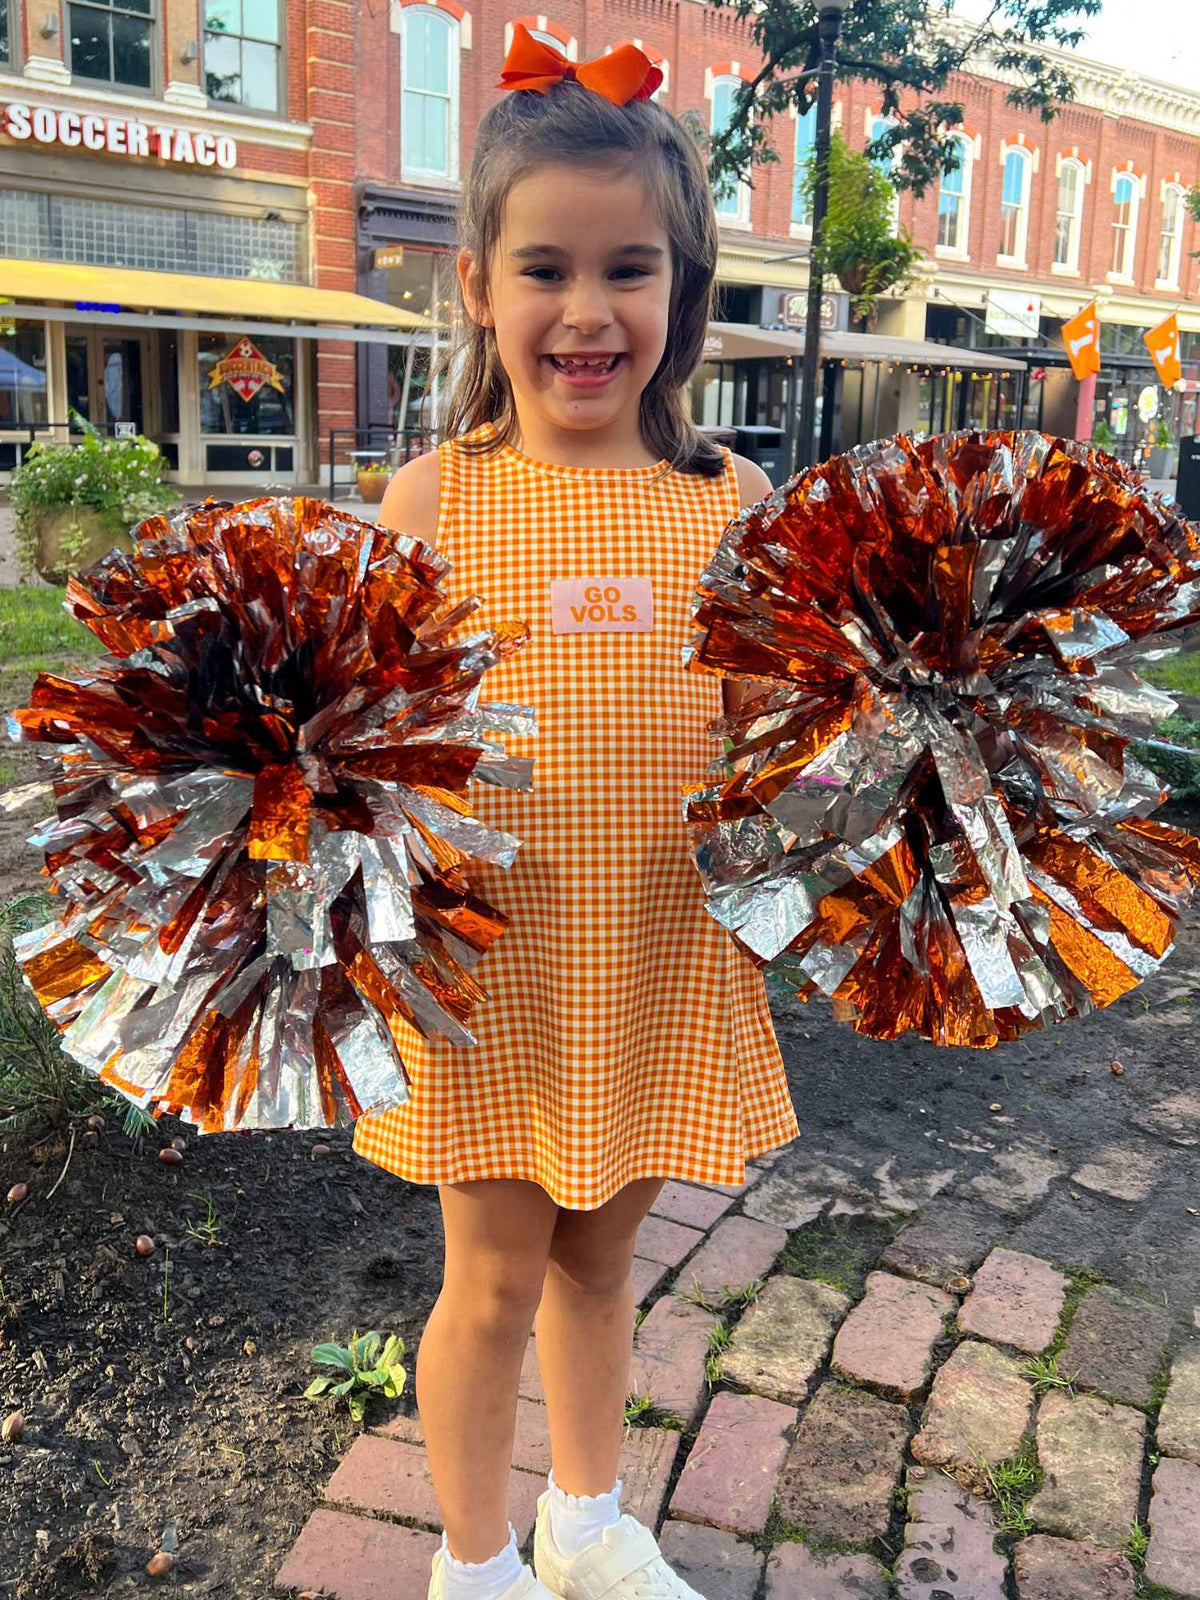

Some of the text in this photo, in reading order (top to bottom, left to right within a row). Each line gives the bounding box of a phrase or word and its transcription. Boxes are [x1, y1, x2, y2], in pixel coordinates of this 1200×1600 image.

[6, 102, 238, 168] SOCCER TACO
[585, 586, 621, 603] GO
[570, 605, 637, 622] VOLS
